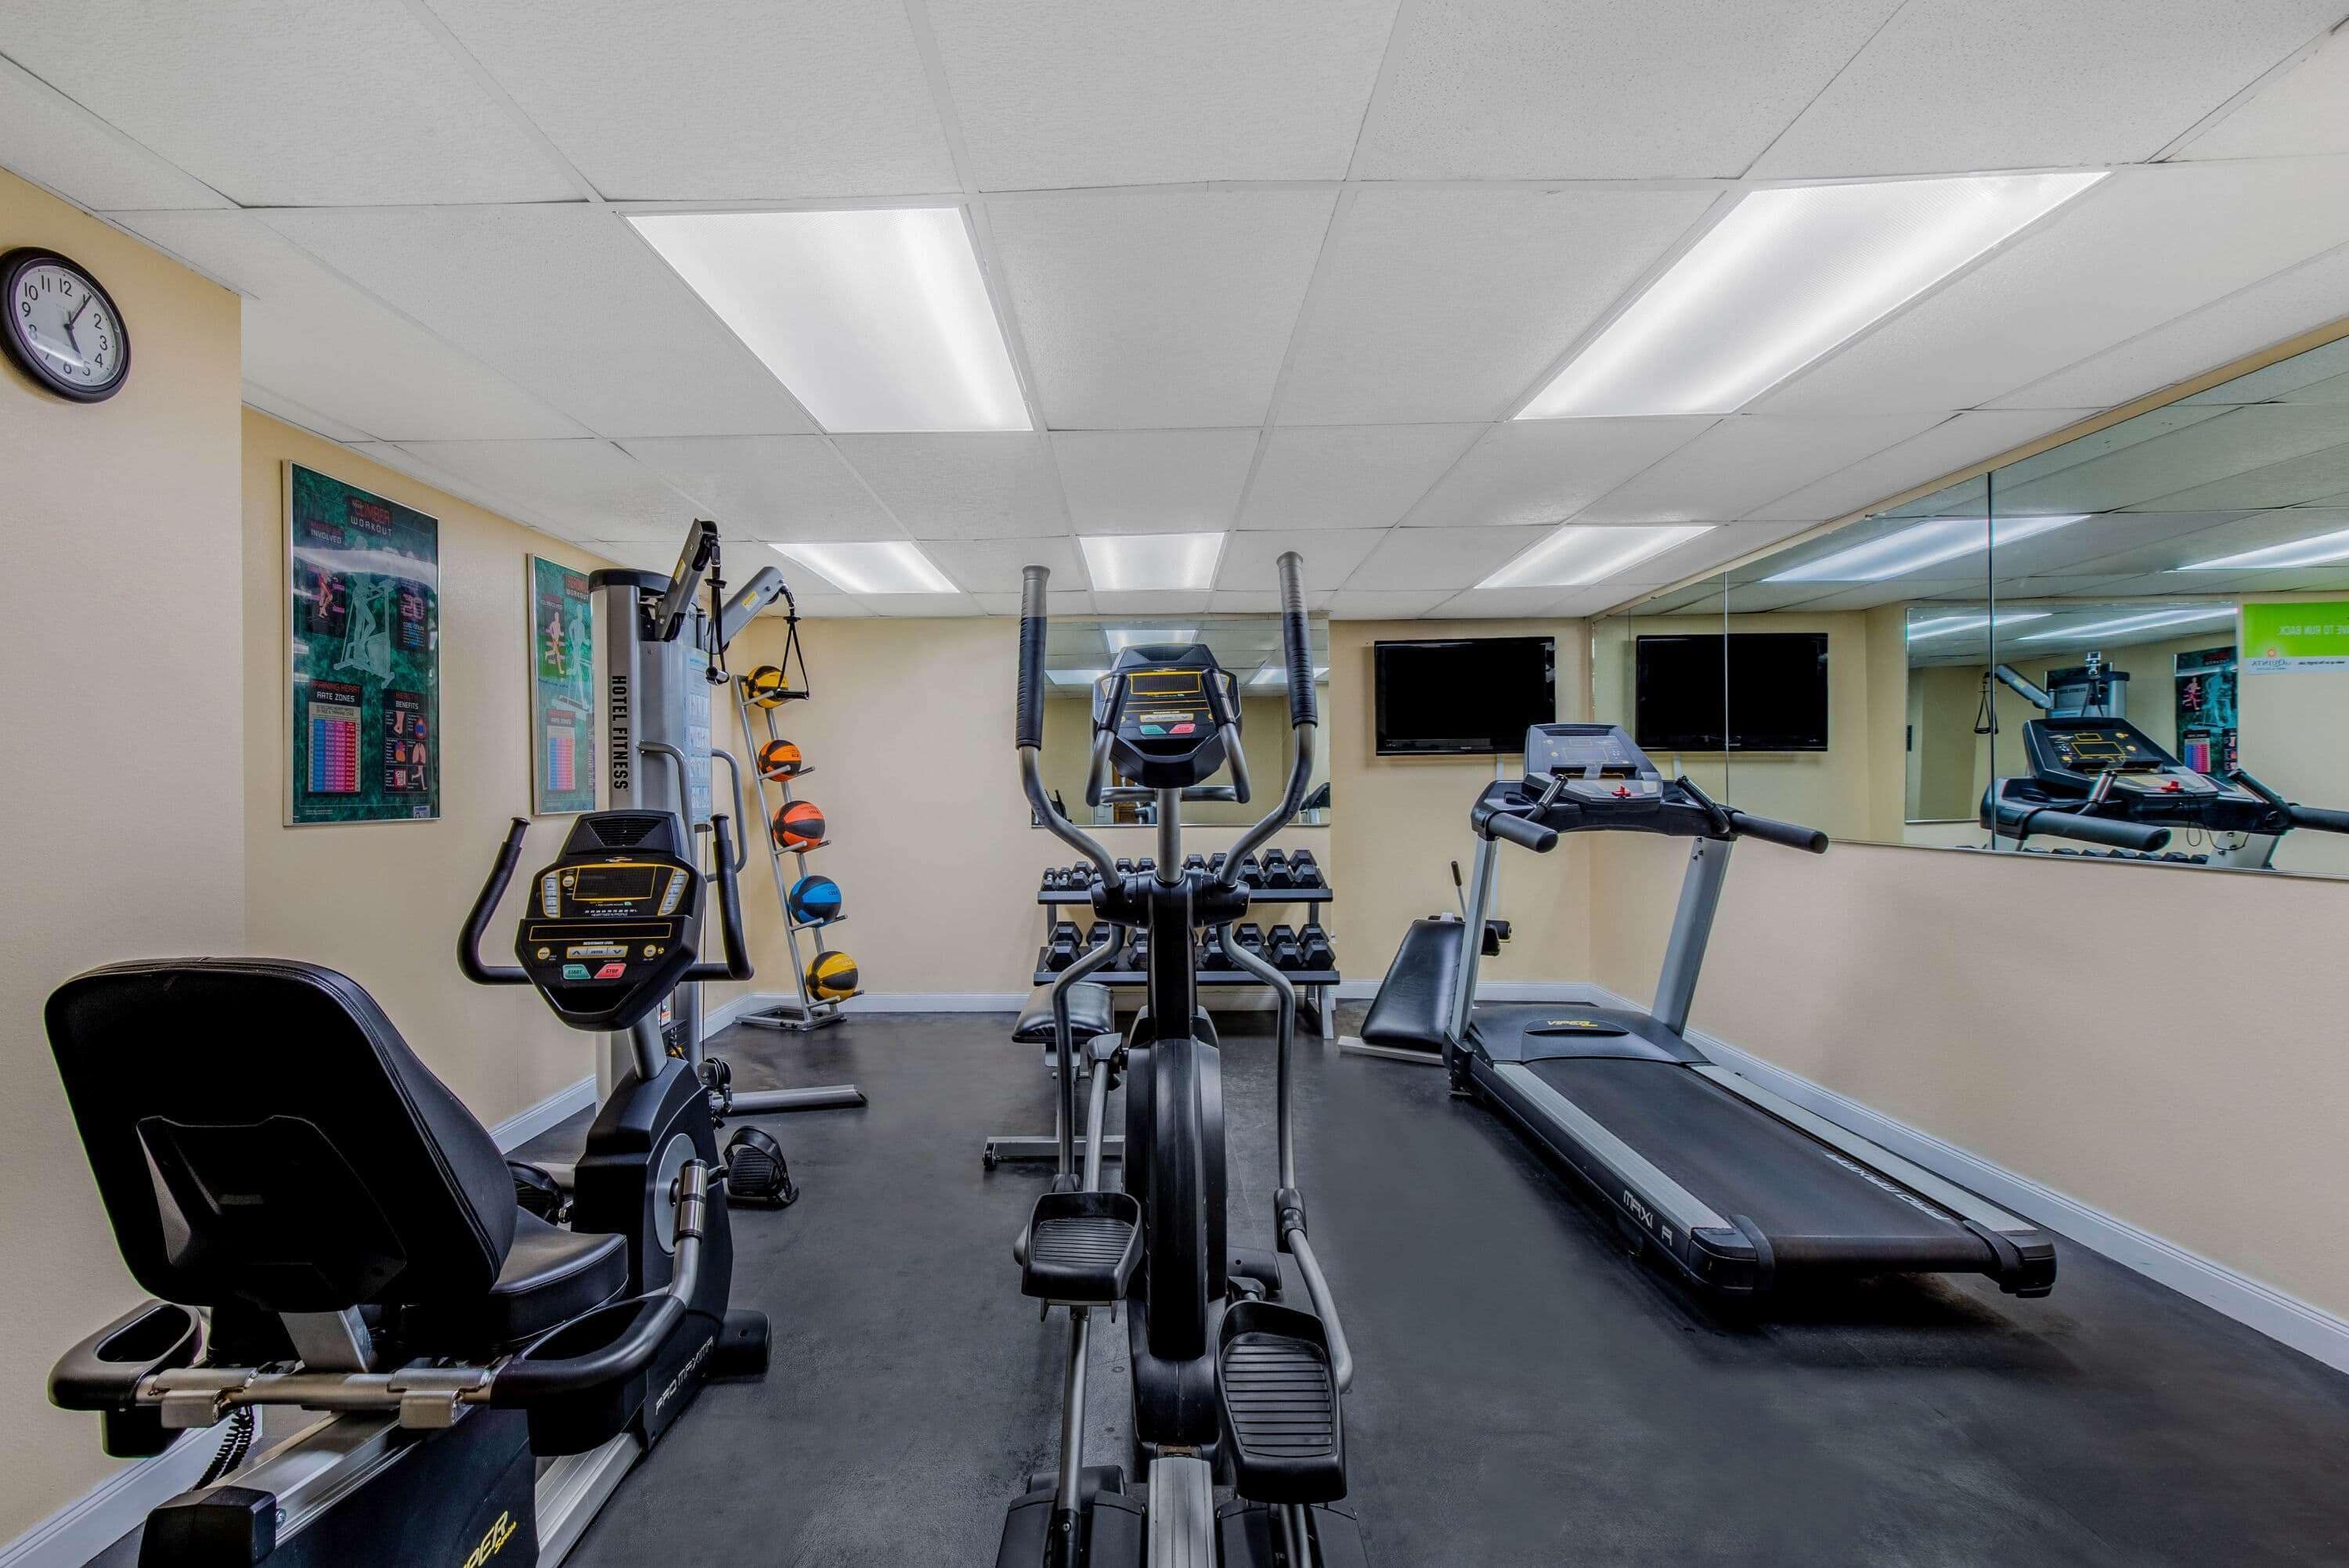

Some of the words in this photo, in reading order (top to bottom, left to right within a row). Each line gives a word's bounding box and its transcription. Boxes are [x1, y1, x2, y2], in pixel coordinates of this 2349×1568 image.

[24, 282, 38, 301] 10
[41, 275, 51, 292] 11
[60, 278, 72, 297] 12
[22, 301, 31, 317] 9
[93, 313, 103, 330] 2
[29, 324, 38, 340] 8
[99, 335, 108, 351] 3
[63, 361, 72, 374] 6
[82, 360, 91, 376] 5
[94, 352, 103, 368] 4
[350, 517, 392, 536] WORKOUT
[311, 529, 342, 544] INVOLVED
[316, 691, 333, 700] RATE
[335, 694, 355, 702] ZONES
[612, 676, 627, 721] HOTEL
[395, 701, 419, 710] BENEFITS
[612, 727, 629, 790] FITNESS
[655, 1379, 677, 1416] PRO
[678, 1335, 714, 1386] MAXIMA
[463, 1510, 508, 1568] PER
